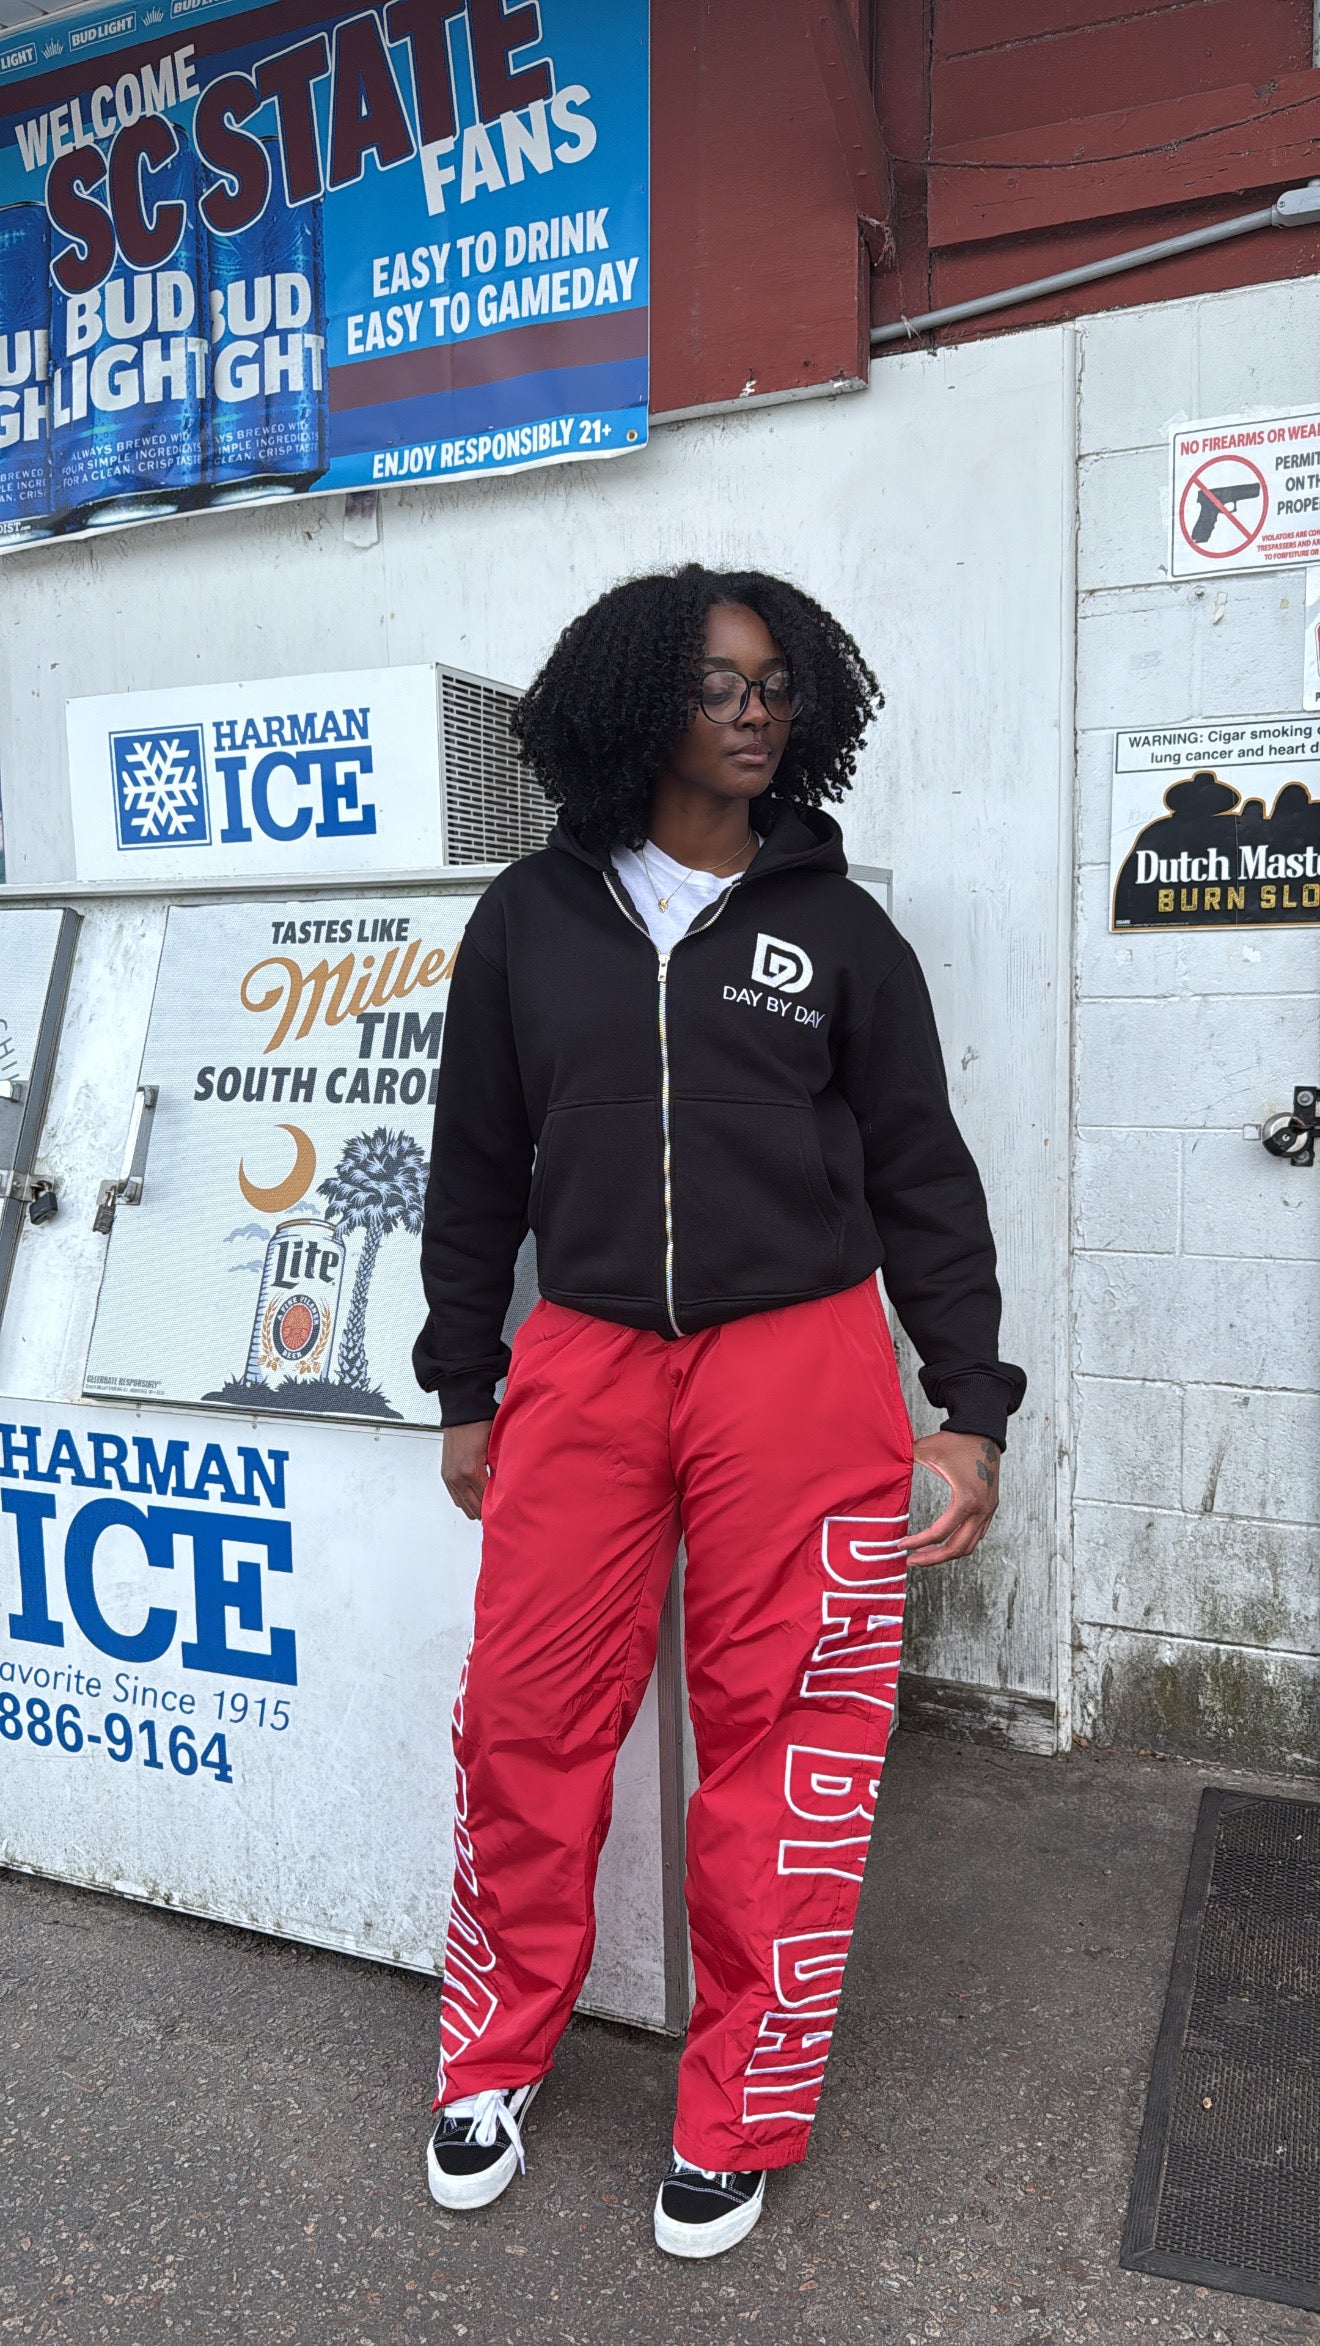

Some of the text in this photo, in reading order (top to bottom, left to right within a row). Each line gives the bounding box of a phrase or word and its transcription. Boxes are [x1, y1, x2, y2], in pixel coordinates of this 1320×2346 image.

[72, 15, 134, 47] BUD LIGHT
[0, 47, 35, 70] LIGHT
[15, 43, 200, 172] WELCOME
[45, 0, 556, 296] SC STATE
[420, 84, 598, 217] FANS
[372, 207, 610, 299] EASY TO DRINK
[66, 270, 195, 357] BUD
[347, 256, 640, 356] EASY TO GAMEDAY
[53, 336, 208, 429] LIGHT
[71, 444, 112, 462] ALWAYS
[116, 434, 167, 453] BREWED
[237, 423, 285, 440] BREWED
[372, 418, 612, 479] ENJOY RESPONSIBLY 21+
[1180, 423, 1320, 456] NO FIREARMS OR WEA
[62, 461, 84, 476] FOUR
[87, 453, 131, 470] SIMPLE
[258, 444, 293, 459] CRISP
[63, 475, 79, 489] FOR
[82, 475, 89, 483] A
[91, 464, 135, 481] CLEAN,
[138, 456, 174, 473] CRISP
[1285, 475, 1305, 492] ON
[1261, 531, 1295, 542] VIOLATORS
[1296, 530, 1308, 538] ARE
[1298, 540, 1311, 548] AND
[212, 707, 371, 753] HARMAN
[1129, 732, 1204, 748] WARNING:
[1208, 730, 1246, 745] Cigar
[1250, 725, 1312, 741] smoking
[1151, 752, 1181, 765] lung
[1185, 748, 1233, 761] cancer
[1237, 745, 1264, 758] and
[1268, 743, 1306, 756] heart
[215, 745, 377, 844] ICE
[1134, 847, 1231, 884] Dutch
[1158, 885, 1246, 912] BURN
[271, 918, 410, 945] TASTES LIKE
[722, 985, 826, 1029] DAY BY DAY
[193, 1066, 318, 1104] SOUTH
[270, 1240, 340, 1290] Lite
[0, 1422, 290, 1510] HARMAN
[1, 1487, 298, 1687] ICE
[113, 1672, 196, 1715] Since
[213, 1690, 291, 1732] 1915
